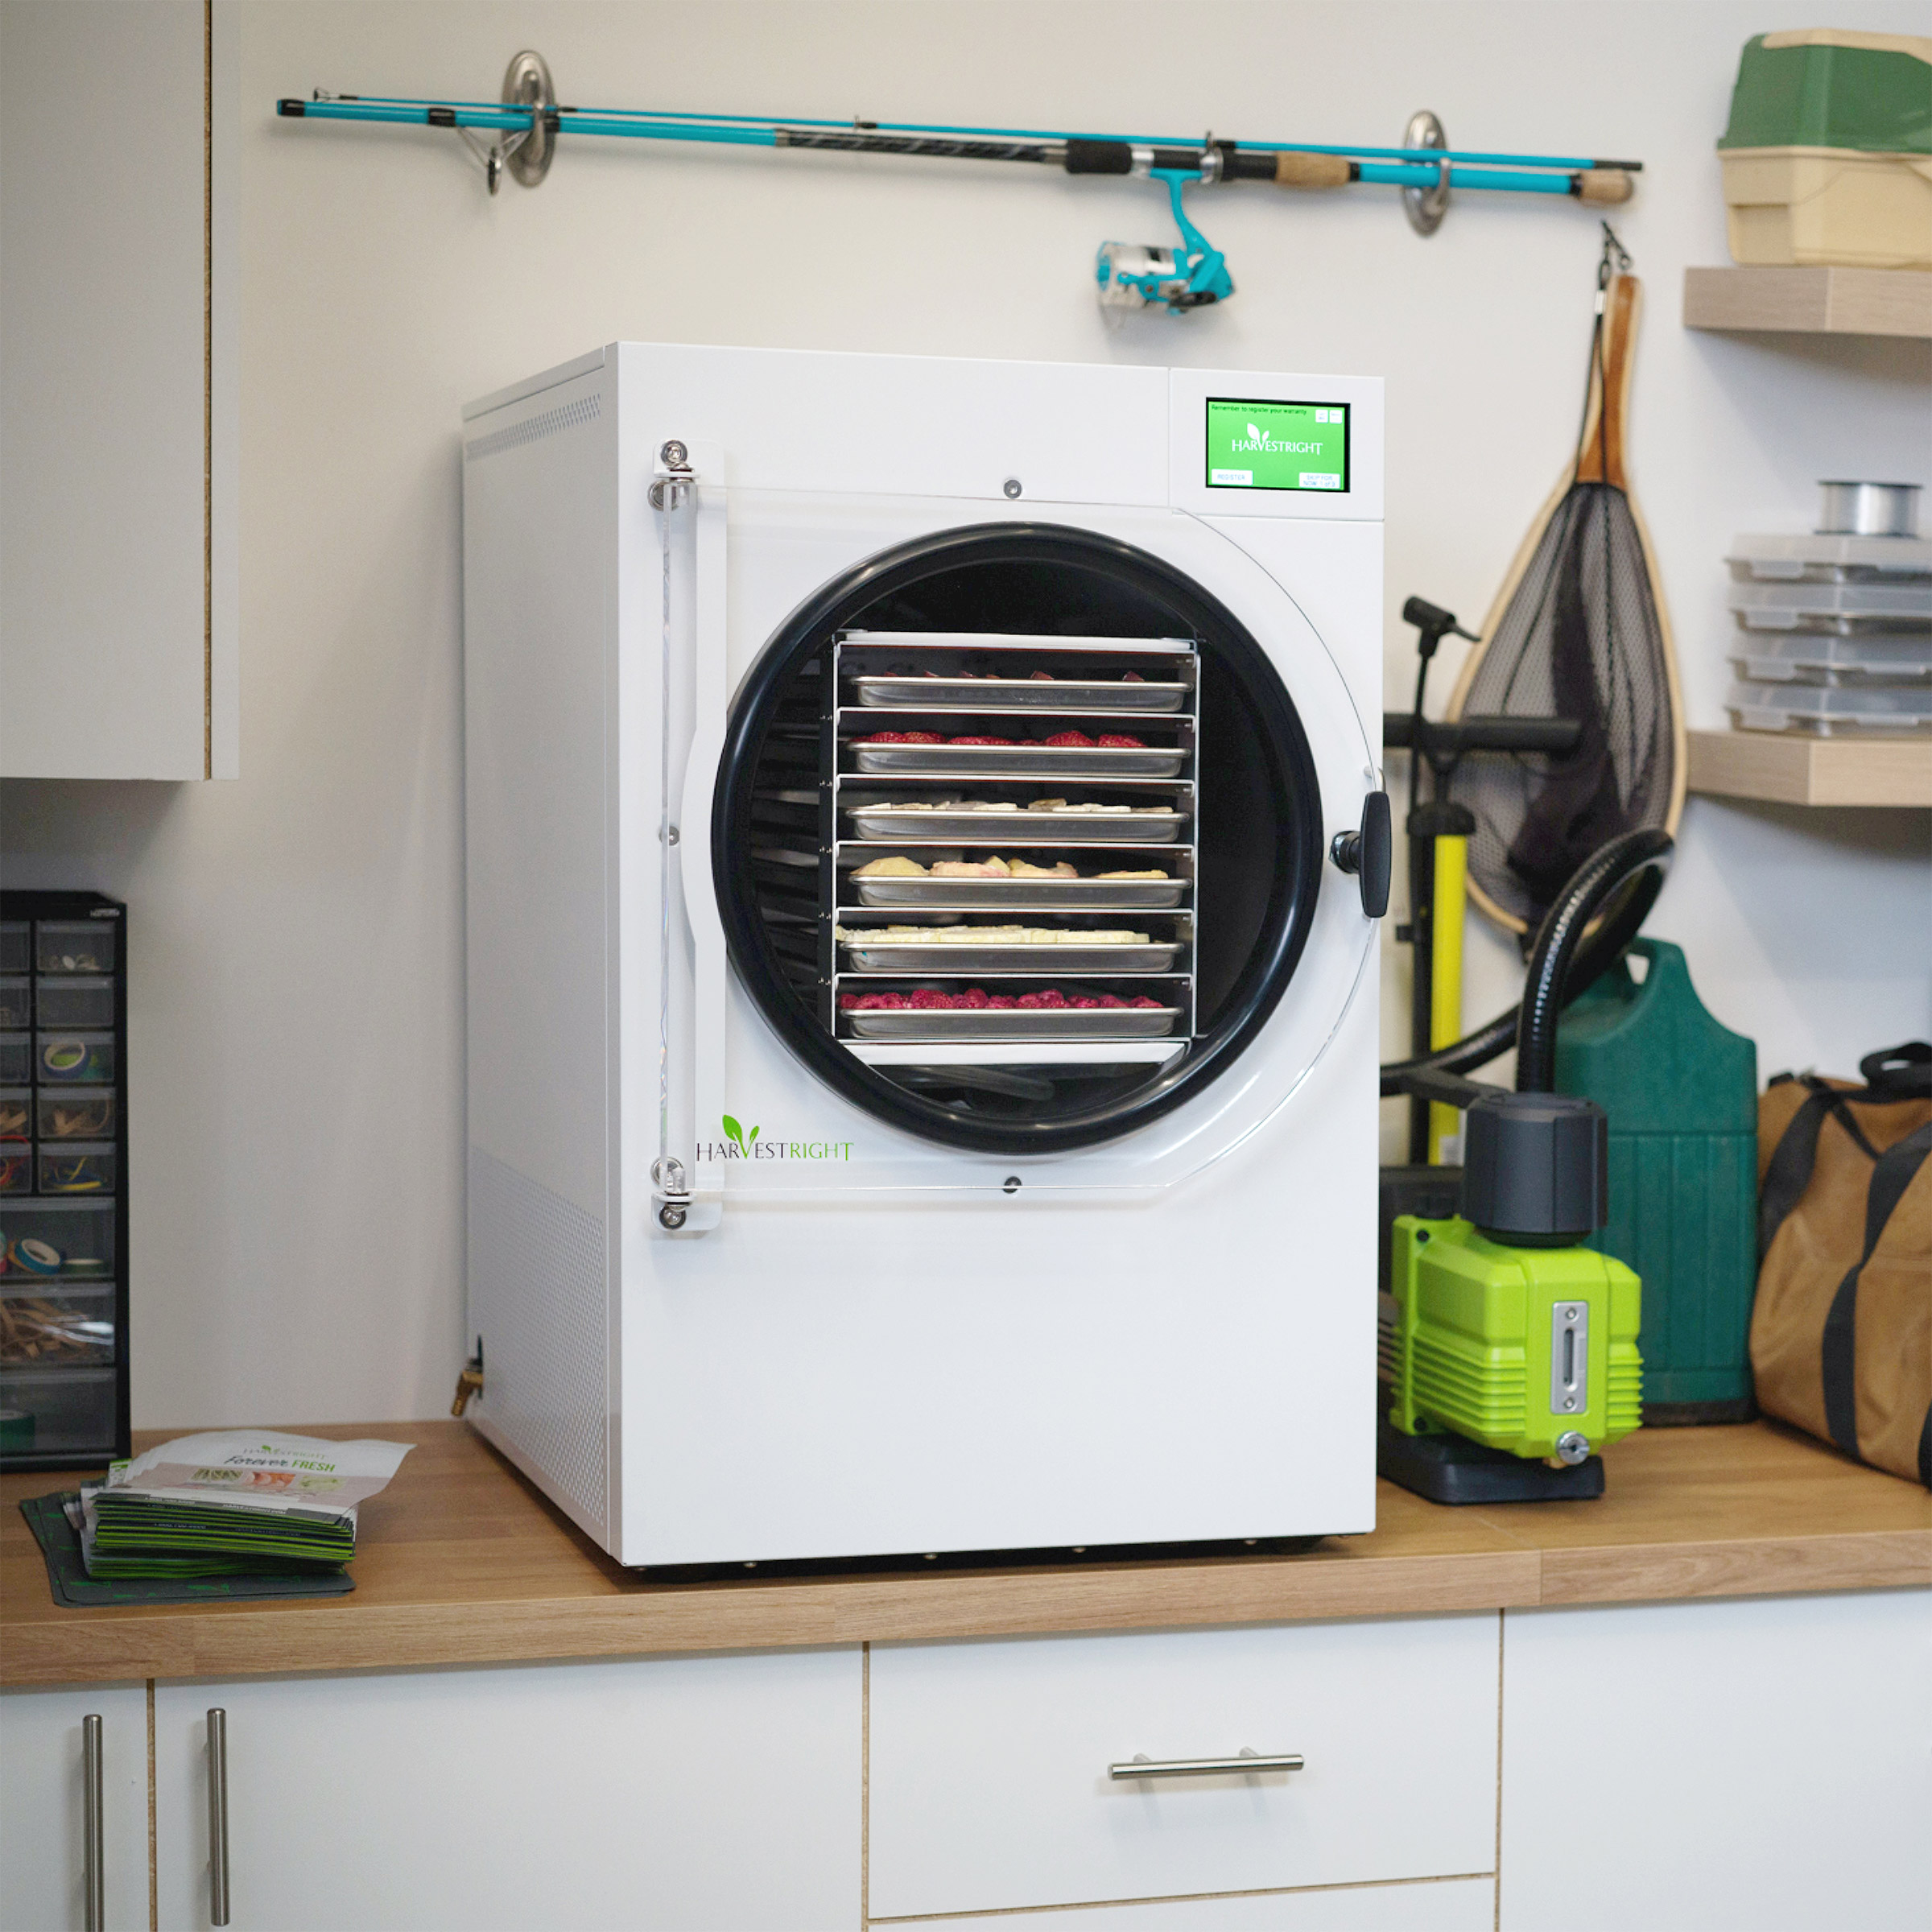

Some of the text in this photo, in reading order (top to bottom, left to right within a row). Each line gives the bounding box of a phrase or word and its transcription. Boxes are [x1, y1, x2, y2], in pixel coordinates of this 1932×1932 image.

[1232, 436, 1323, 455] HARVESTRIGHT
[696, 1130, 854, 1162] HARVESTRIGHT
[224, 1455, 336, 1472] Forever FRESH
